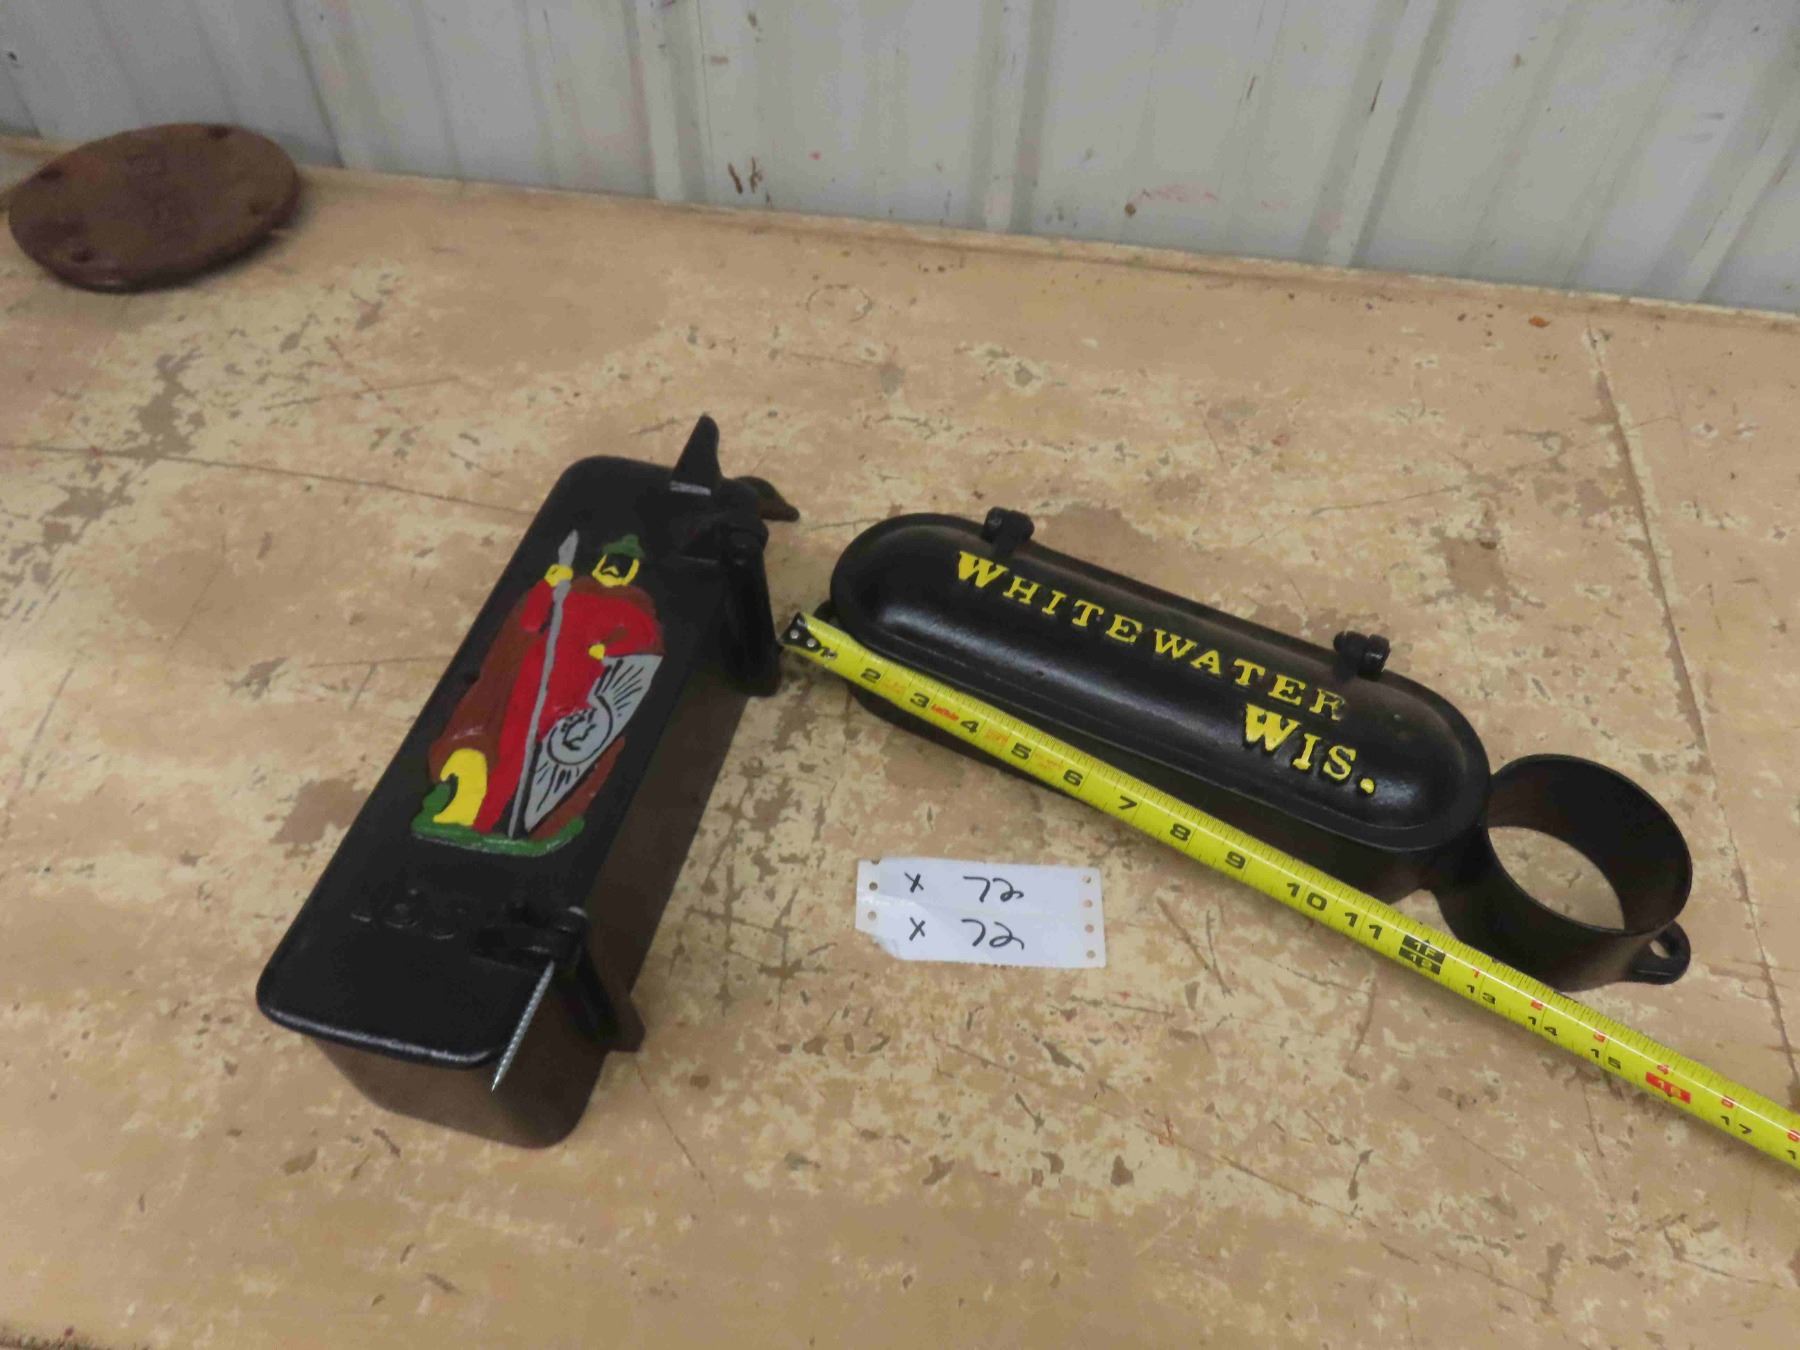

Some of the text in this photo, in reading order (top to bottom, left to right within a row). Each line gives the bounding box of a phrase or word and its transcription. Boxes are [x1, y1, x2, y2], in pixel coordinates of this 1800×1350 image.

[957, 551, 1348, 722] WHITEWATER
[1243, 703, 1377, 796] WIS.
[861, 668, 1384, 941] 2 3 4 5 6 7 8 9 10 11
[961, 918, 1025, 950] 72
[962, 875, 1024, 903] 72
[1528, 1016, 1558, 1037] 14
[1591, 1048, 1621, 1070] 15
[1720, 1114, 1752, 1134] 17
